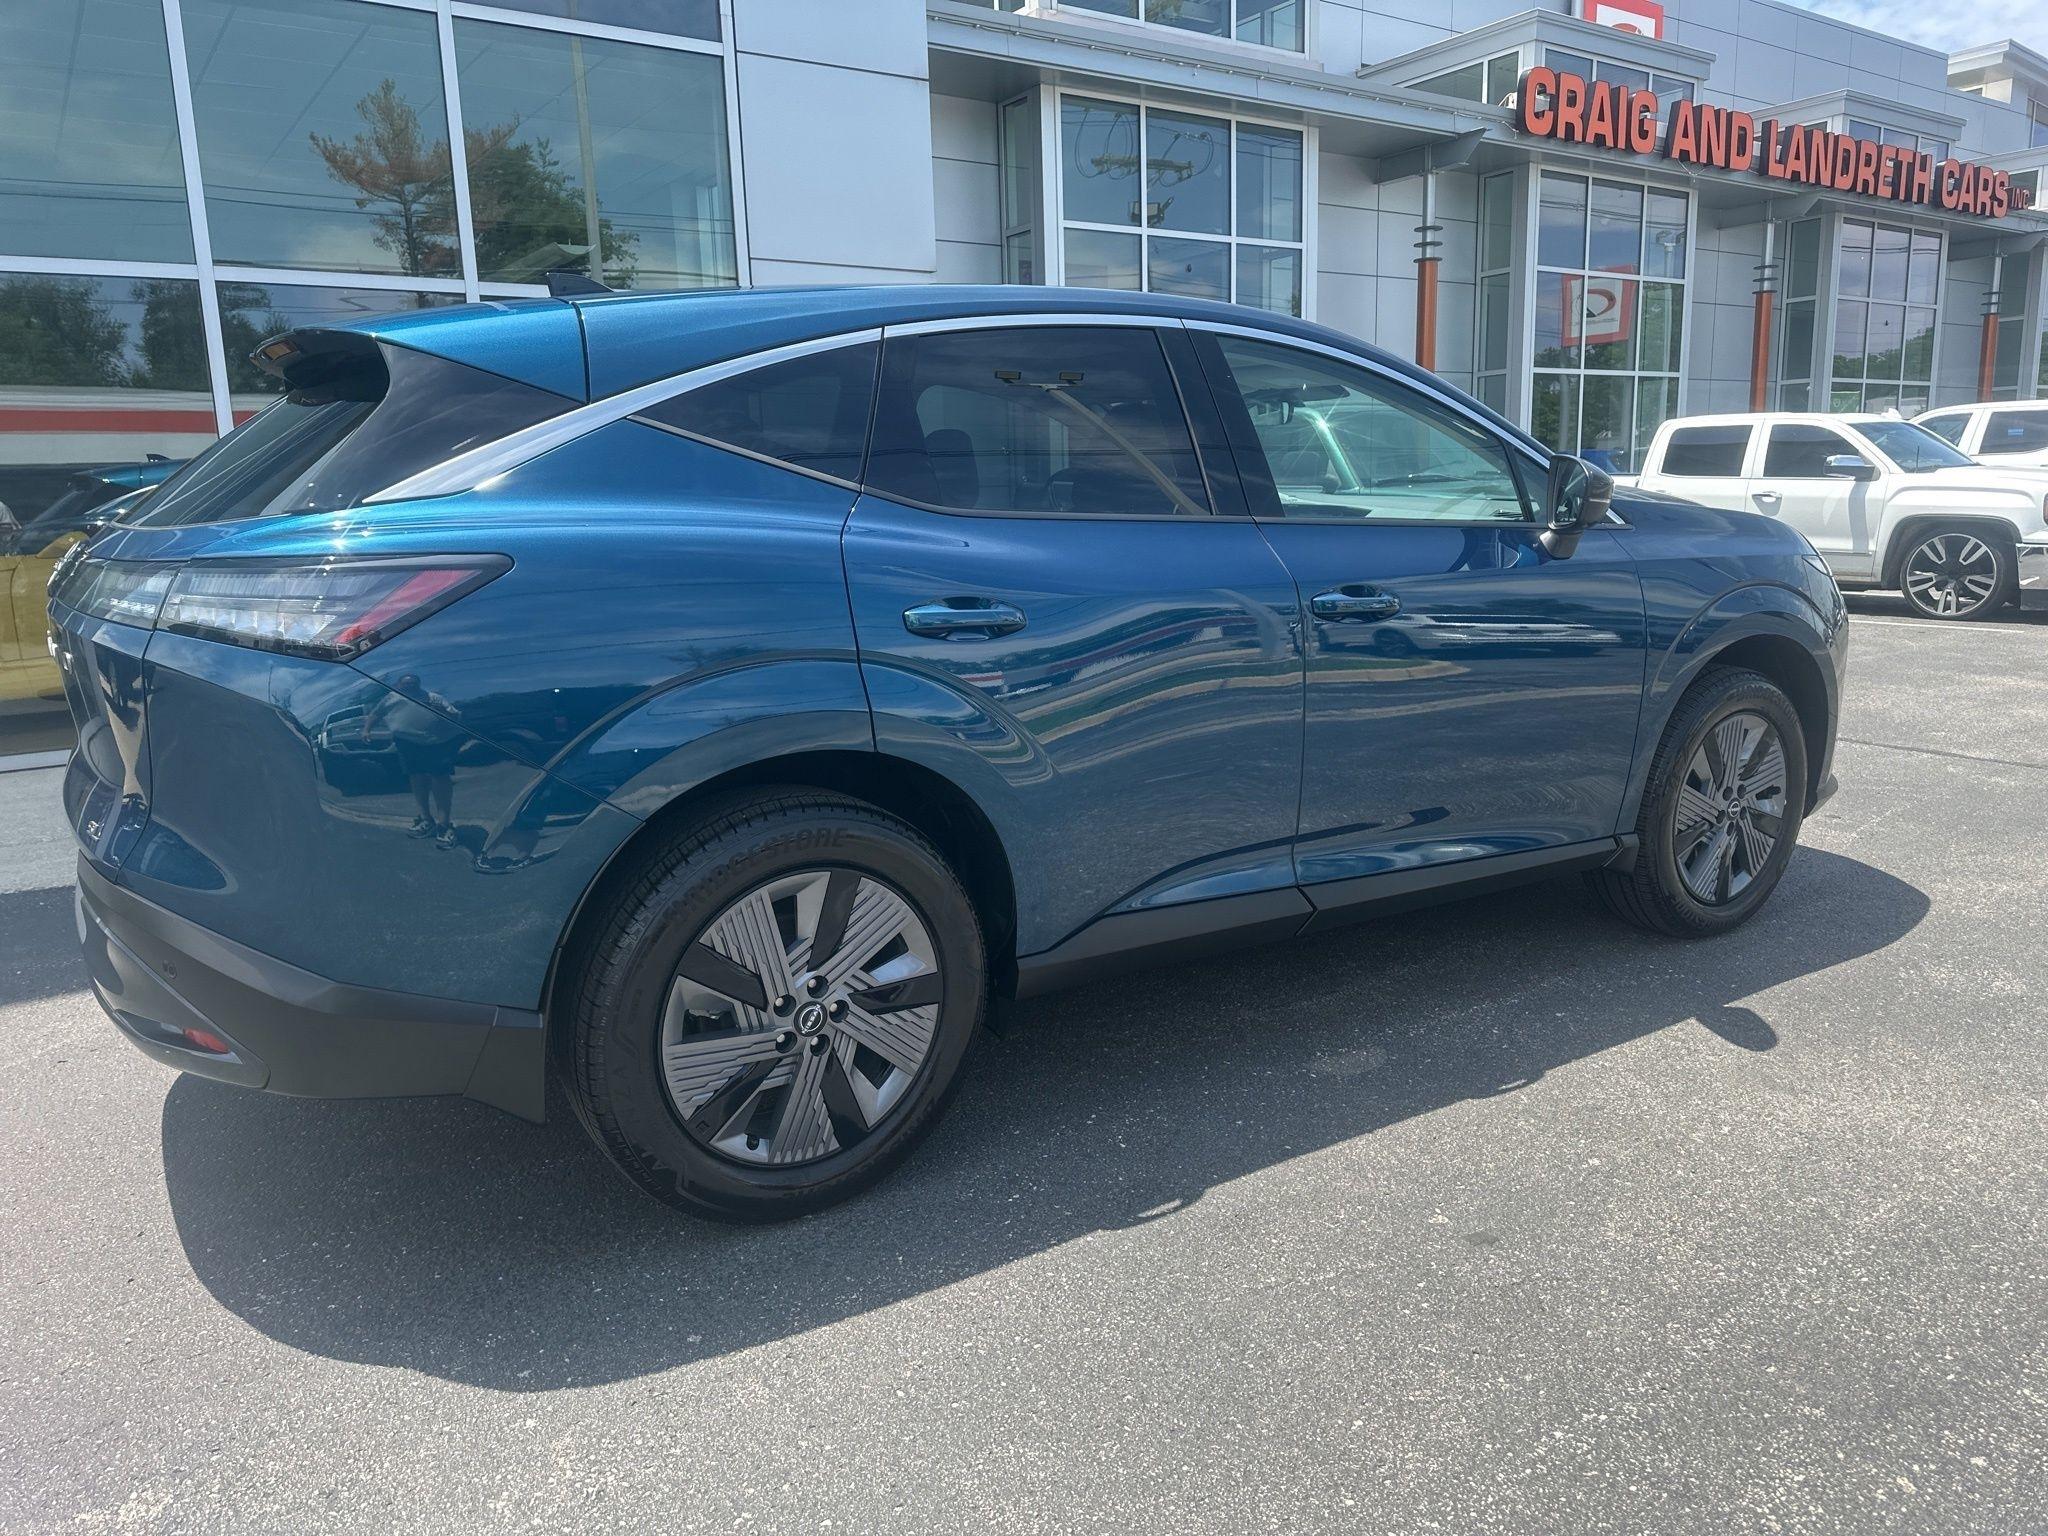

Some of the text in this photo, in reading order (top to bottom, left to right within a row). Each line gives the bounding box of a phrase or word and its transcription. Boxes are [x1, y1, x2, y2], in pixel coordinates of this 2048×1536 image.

[1520, 66, 1658, 154] CRAIG
[1667, 99, 1755, 171] AND
[1764, 119, 1933, 204] LANDRETH
[1938, 158, 2010, 218] CARS
